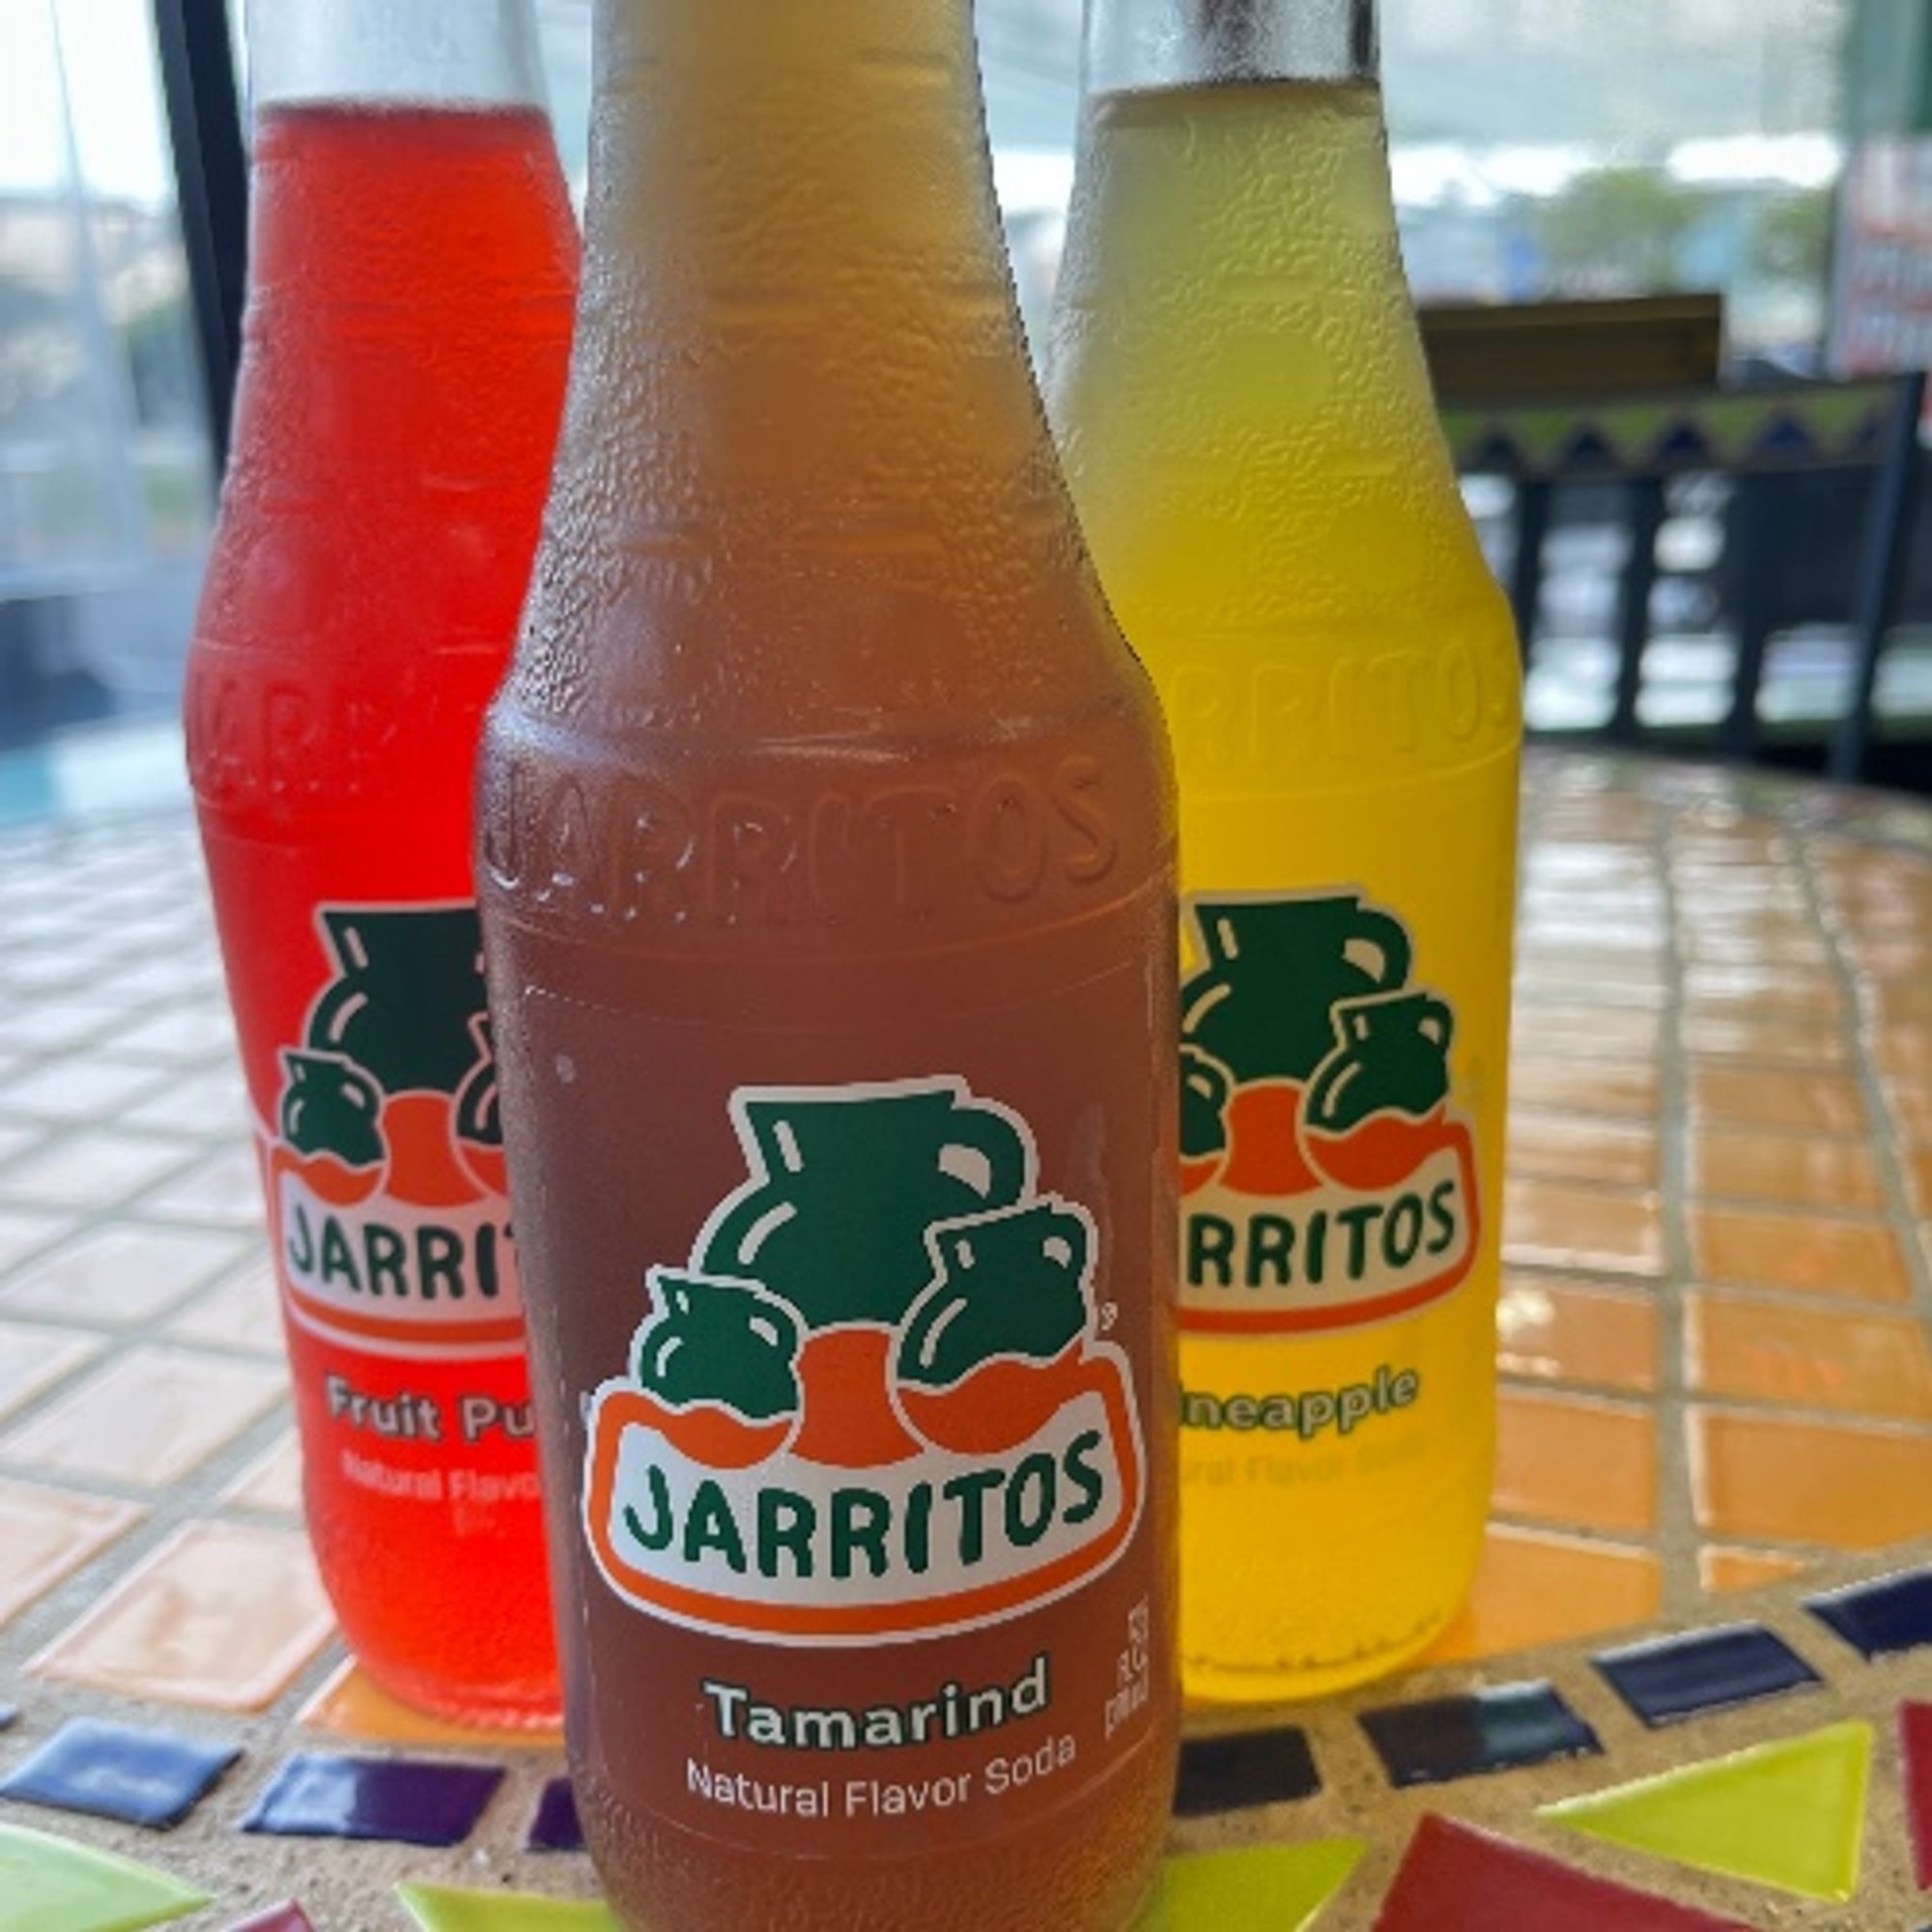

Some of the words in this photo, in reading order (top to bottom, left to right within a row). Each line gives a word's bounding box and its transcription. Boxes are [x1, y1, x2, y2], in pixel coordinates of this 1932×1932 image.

[290, 1205, 513, 1299] JARRI
[1187, 1179, 1455, 1287] RRITOS
[325, 1374, 442, 1441] Fruit
[1179, 1364, 1419, 1442] neapple
[624, 1430, 1103, 1578] JARRITOS
[701, 1651, 1051, 1748] Tamarind
[686, 1757, 830, 1817] Natural
[844, 1771, 972, 1818] Flavor
[984, 1733, 1077, 1795] Soda
